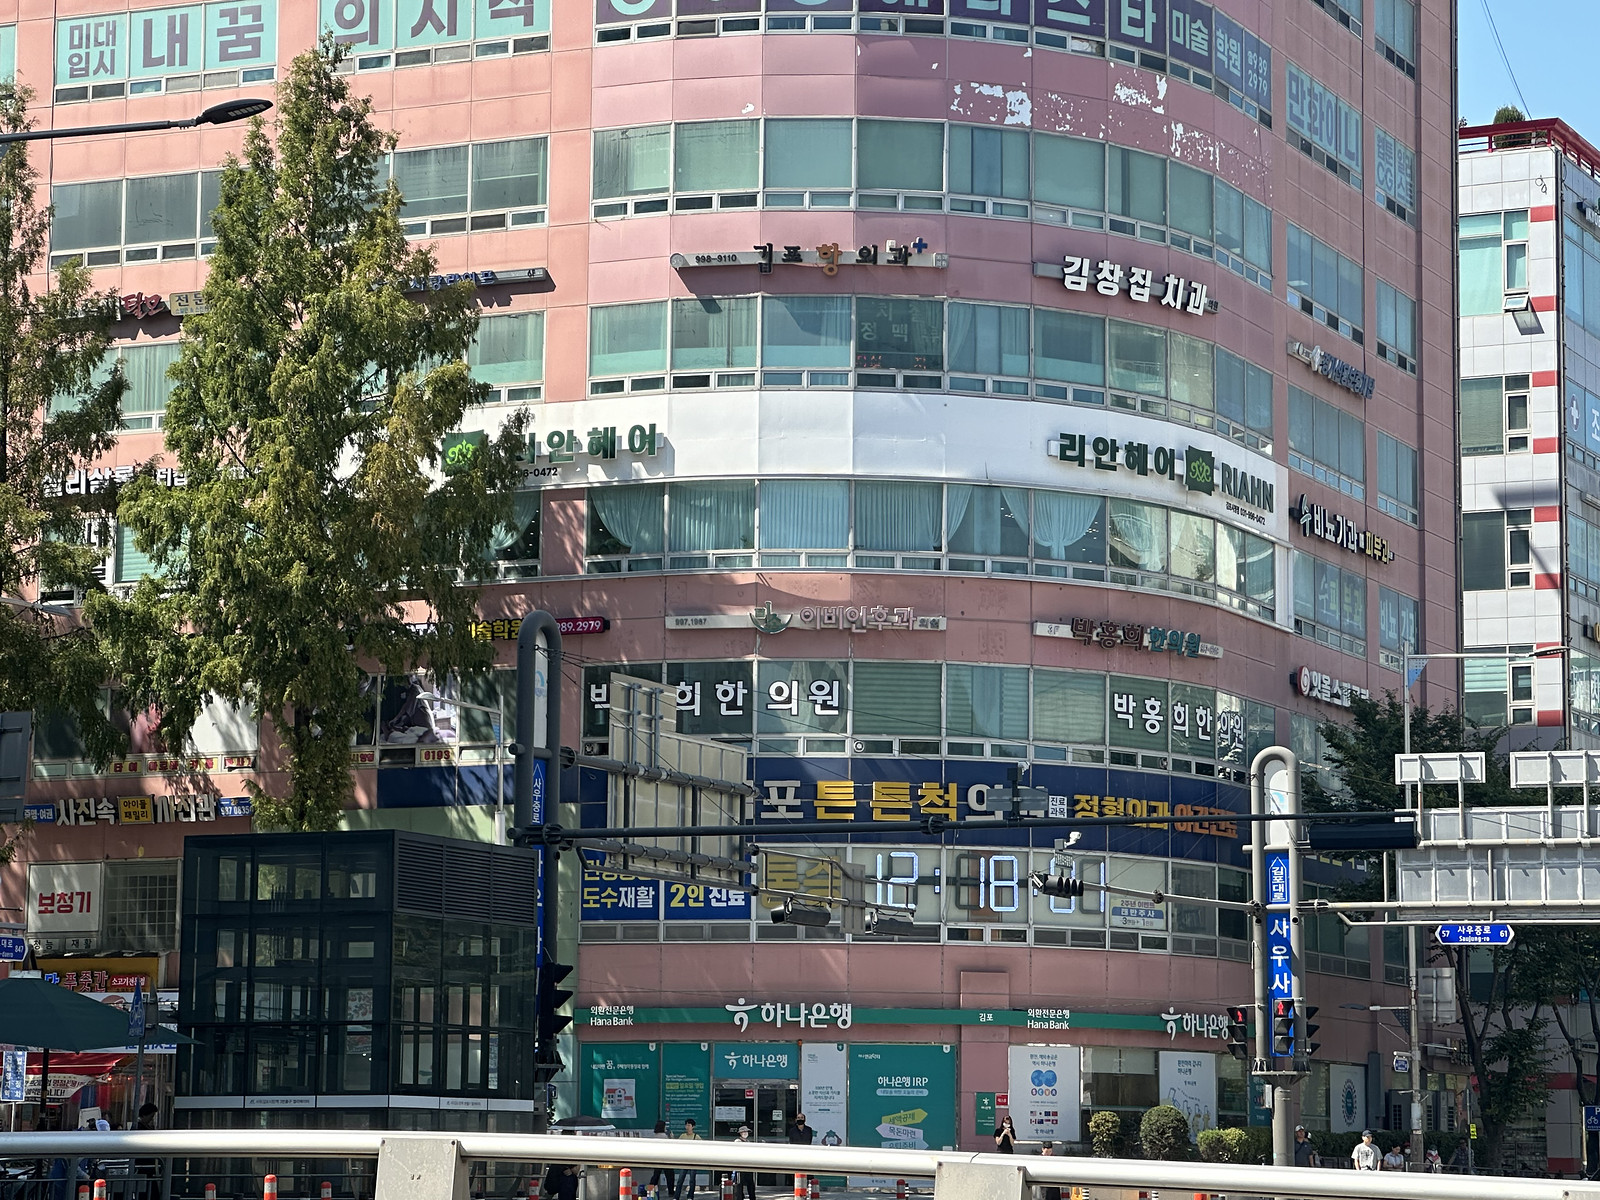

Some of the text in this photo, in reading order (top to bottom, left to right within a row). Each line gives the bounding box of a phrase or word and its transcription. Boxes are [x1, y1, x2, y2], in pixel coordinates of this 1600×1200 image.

[69, 20, 117, 47] 미대
[68, 49, 115, 79] 입시
[1248, 70, 1268, 96] 2979
[695, 254, 738, 263] 998-9110
[1059, 433, 1274, 513] 리안헤어 RIAHN
[1314, 504, 1389, 564] 비뇨기과 피부과
[800, 605, 917, 633] 이비인후과
[123, 800, 147, 809] 아이돌
[1050, 797, 1067, 807] 진료
[57, 797, 116, 826] 사진속
[124, 810, 149, 820] 패밀리
[1271, 867, 1286, 900] 김포대로
[38, 891, 92, 914] 보청기
[1458, 925, 1492, 935] 사우중로
[590, 1005, 634, 1015] 외환전문은행
[761, 1003, 852, 1030] 하나은행
[1027, 1009, 1070, 1019] 외환전문은행
[590, 1016, 634, 1026] Hana Bank
[979, 1013, 994, 1023] 김포
[1027, 1020, 1070, 1030] Hana Bank
[1182, 1012, 1230, 1041] 하나은행
[743, 1054, 788, 1068] 하나은행
[878, 1076, 929, 1087] 하나은행 IRP
